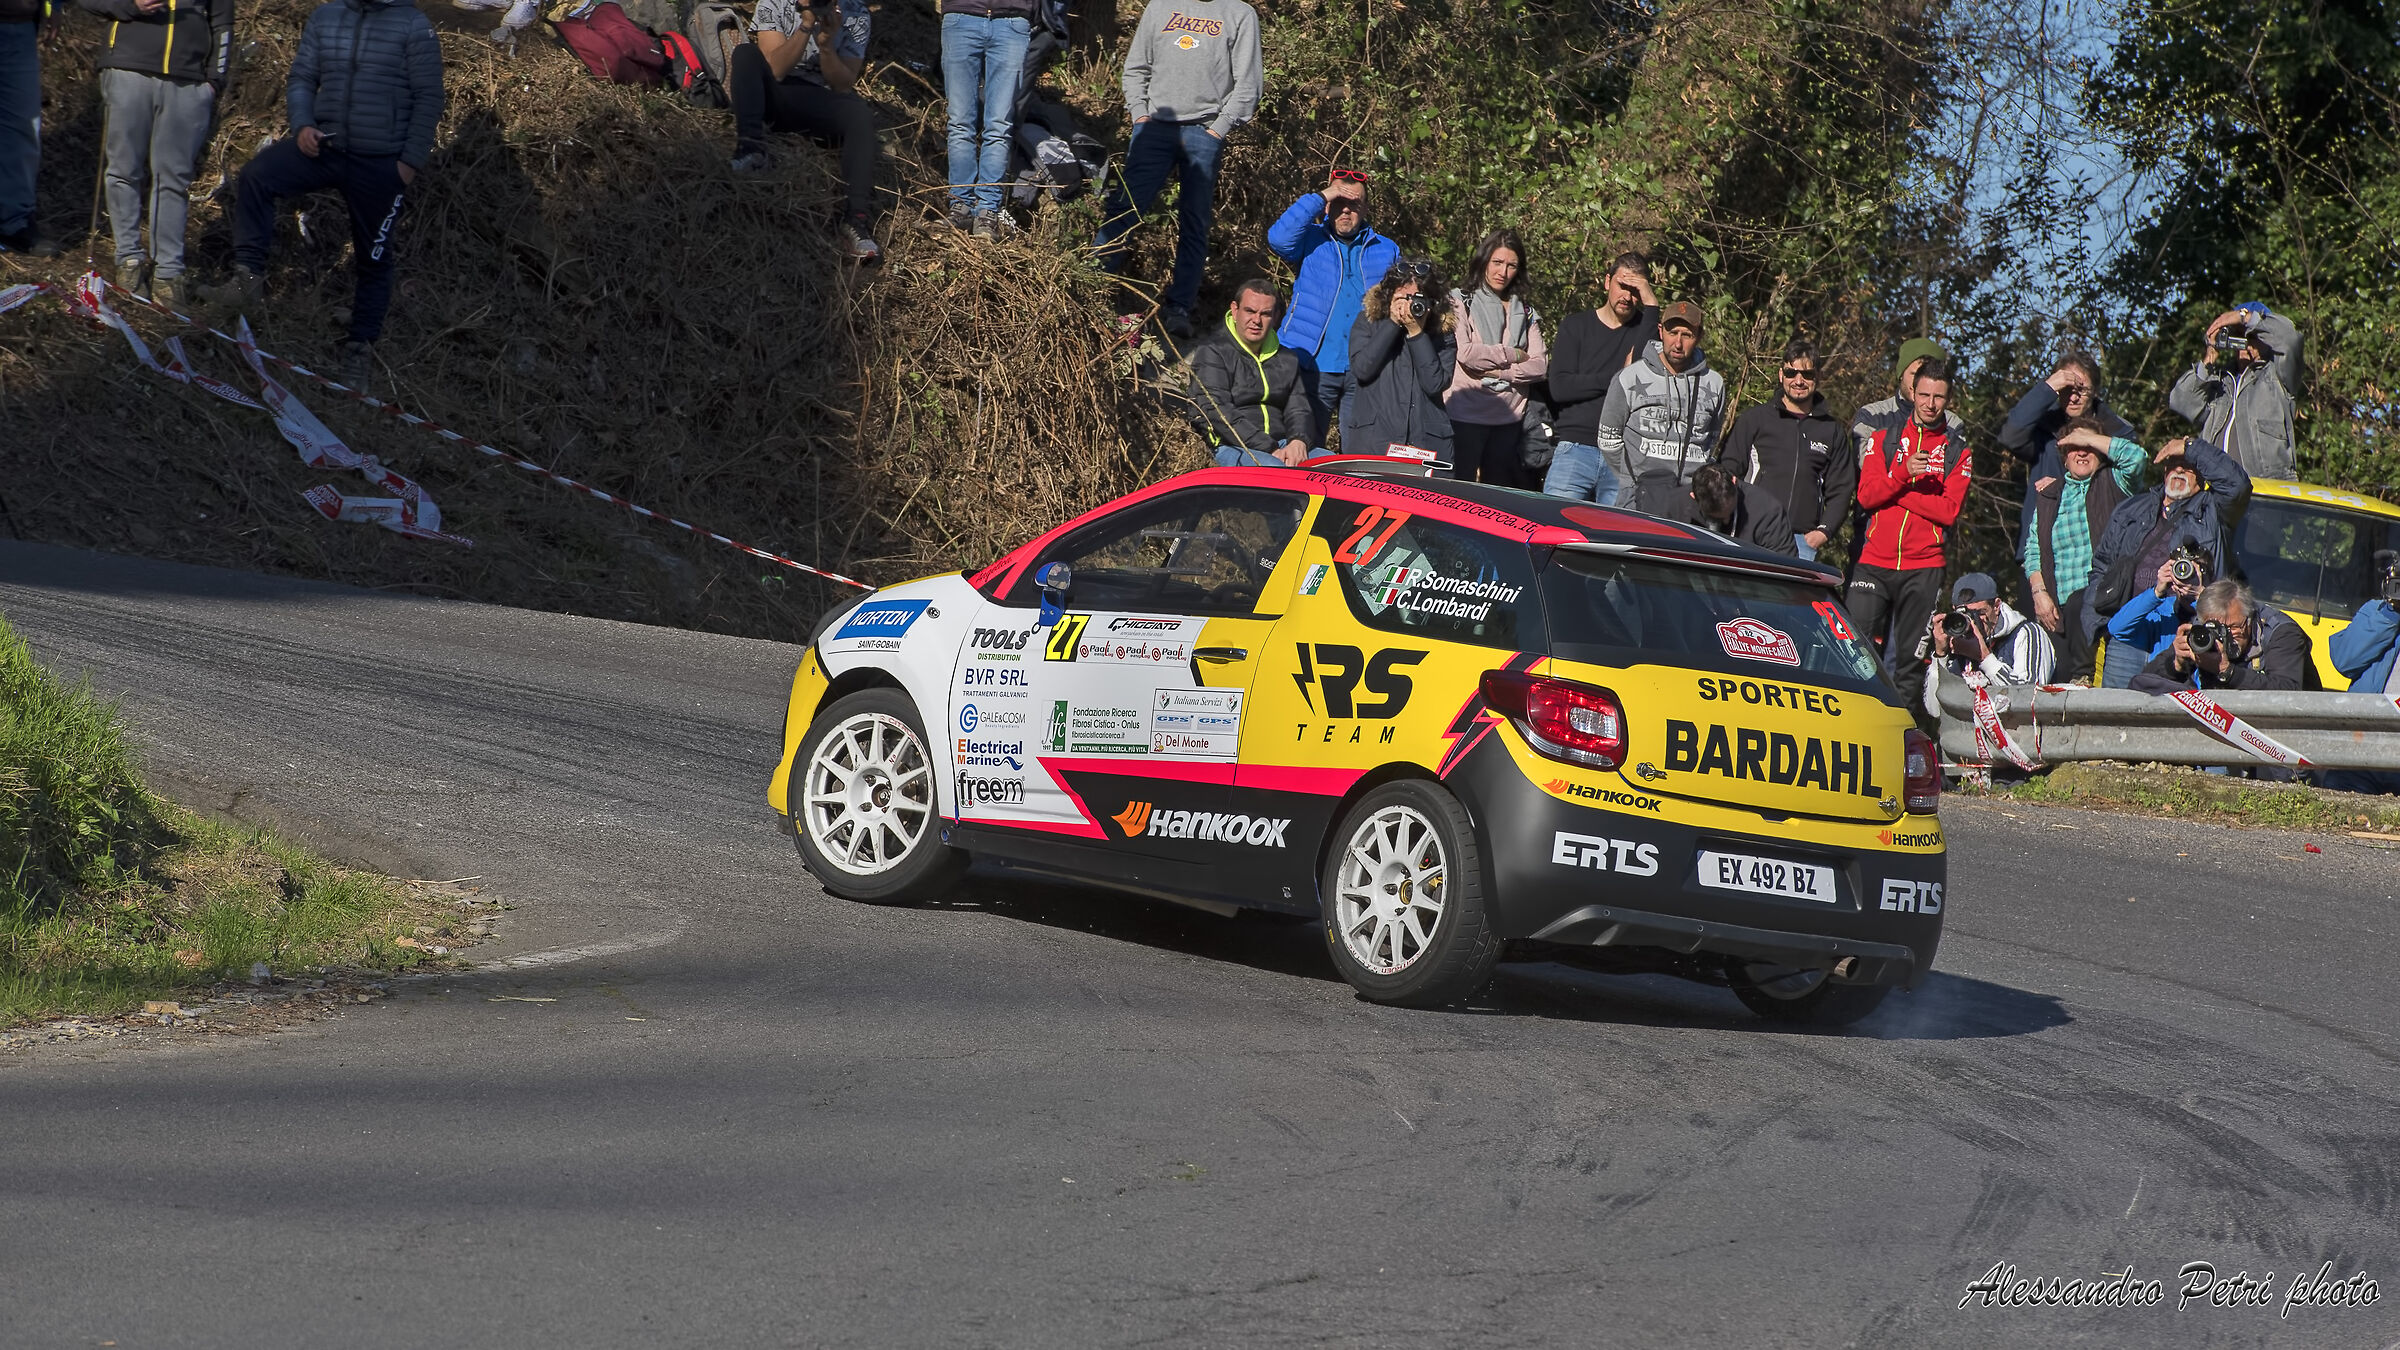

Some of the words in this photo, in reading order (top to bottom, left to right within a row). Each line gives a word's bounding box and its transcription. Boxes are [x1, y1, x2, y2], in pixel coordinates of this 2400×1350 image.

[1162, 12, 1224, 37] LAKERS
[1333, 505, 1413, 566] 27
[1405, 568, 1524, 604] R.Somaschini
[1396, 589, 1491, 622] C.Lombardi
[847, 610, 915, 627] NORTON
[857, 640, 902, 650] SAINT-GOBAIN
[970, 627, 1031, 650] TOOLS
[1045, 614, 1091, 661] 27
[1726, 635, 1751, 653] RALLYE
[1750, 644, 1794, 660] MONTE-CARLO
[977, 653, 1021, 662] DISTRIBUTION
[964, 668, 995, 685] BVR
[999, 669, 1029, 687] SRL
[963, 690, 998, 698] TRATTAMENTI
[1174, 695, 1200, 705] Italiana
[1200, 696, 1223, 707] Servizi
[1697, 677, 1842, 717] SPORTEC
[1073, 707, 1110, 717] Fondazione
[1111, 708, 1137, 718] Ricerca
[1156, 715, 1189, 723] GPS
[1198, 717, 1232, 725] GPS
[2173, 690, 2227, 730] PERICOLOSA
[1071, 730, 1125, 740] fibrosicisticaricerca.it
[1072, 719, 1092, 729] Fibrosi
[1093, 719, 1115, 729] Cistica
[1121, 720, 1140, 729] Onlus
[1296, 723, 1396, 744] TEAM
[957, 738, 1023, 755] Electrical
[1165, 734, 1180, 747] Del
[1181, 736, 1209, 748] Monte
[2240, 729, 2286, 762] cioccorally.it
[957, 754, 1002, 767] Marine
[1665, 719, 1883, 799] BARDAHL
[957, 770, 1024, 804] freem
[1551, 830, 1660, 878] ERTS
[1718, 856, 1744, 885] EX
[1749, 858, 1786, 891] 492
[1793, 865, 1818, 895] BZ
[1880, 878, 1943, 915] ERTS
